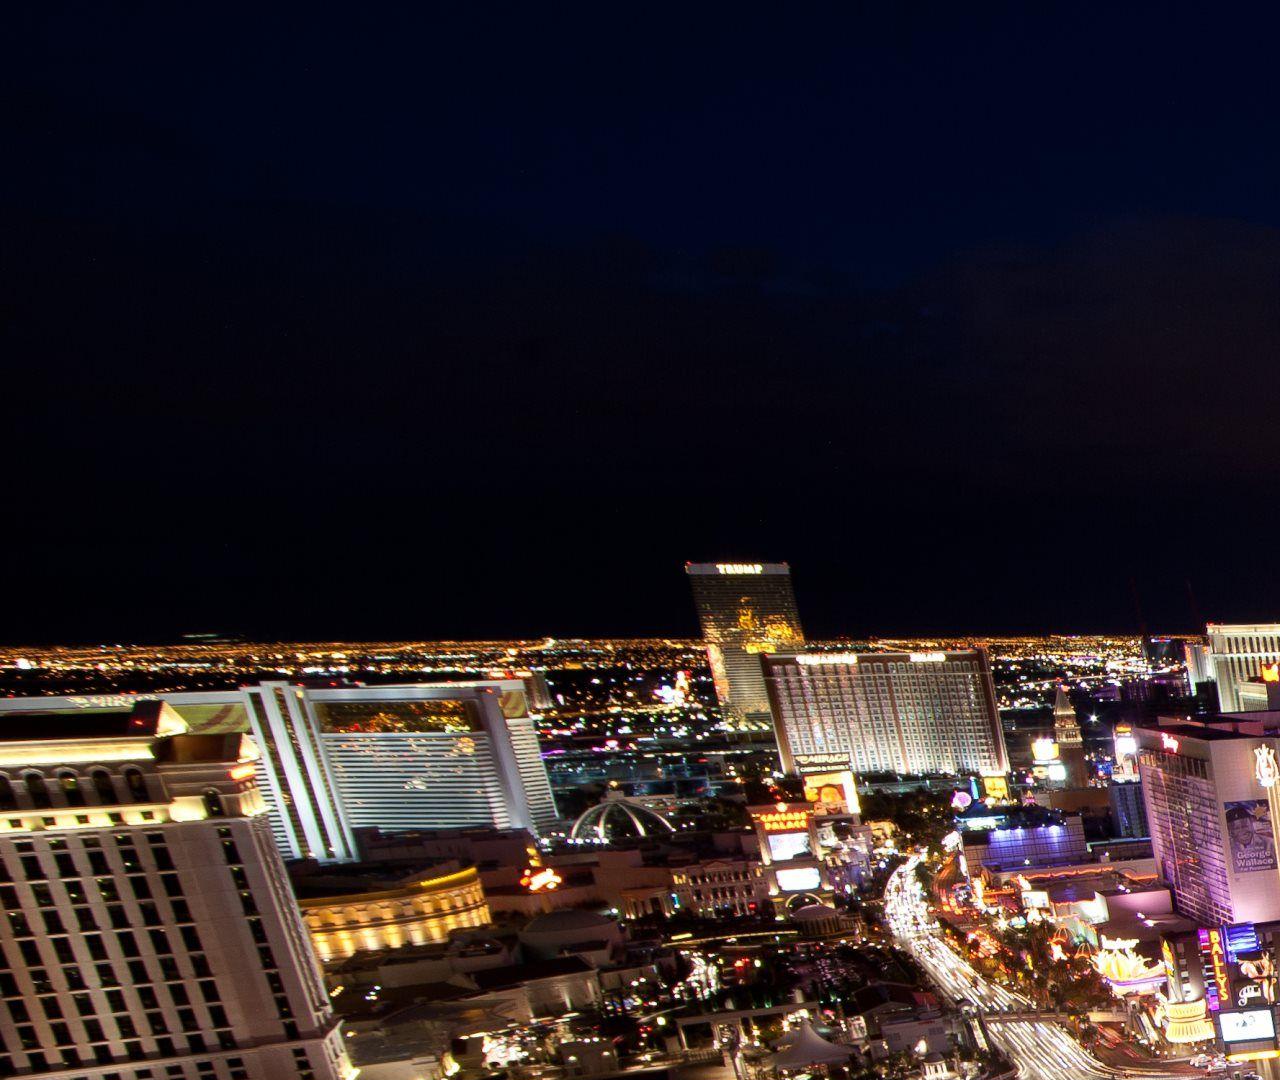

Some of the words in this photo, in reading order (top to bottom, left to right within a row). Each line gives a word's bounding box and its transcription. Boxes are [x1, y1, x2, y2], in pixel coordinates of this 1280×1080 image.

[716, 564, 763, 575] TRUMP
[1237, 849, 1271, 860] George
[1236, 858, 1274, 867] Wallace
